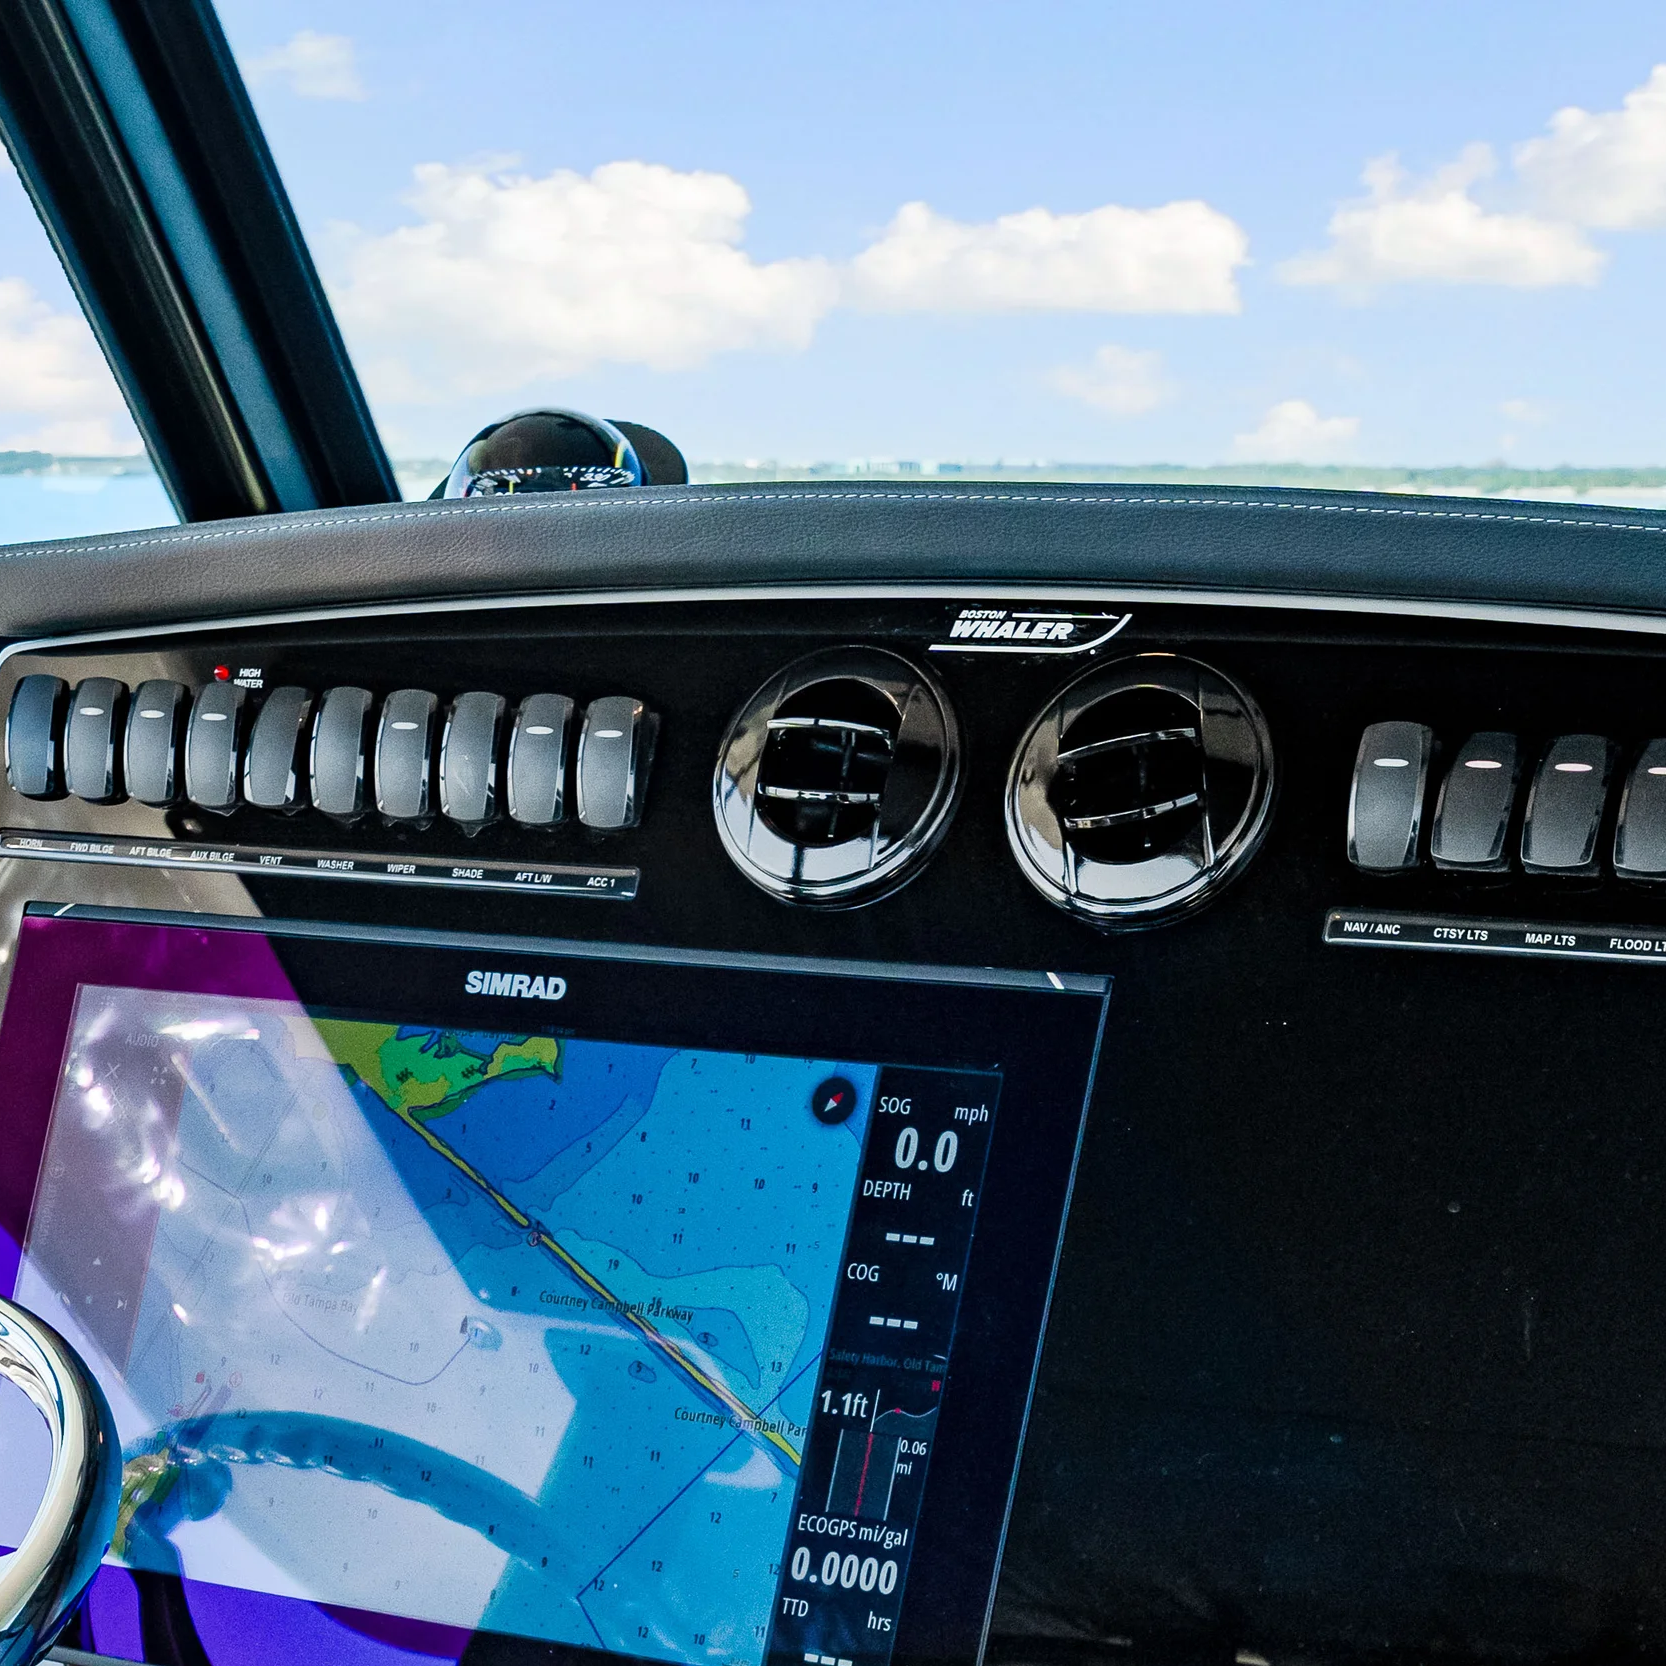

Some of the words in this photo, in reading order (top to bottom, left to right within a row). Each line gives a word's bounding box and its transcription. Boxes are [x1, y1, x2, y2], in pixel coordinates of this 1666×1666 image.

[959, 610, 1007, 619] BOSTON
[950, 621, 1074, 640] WHALER
[239, 669, 261, 677] HIGH
[234, 679, 263, 688] WATER
[20, 839, 42, 847] HORN
[71, 843, 88, 852] FWD
[89, 844, 114, 854] BILGE
[129, 847, 146, 856] AFT
[147, 848, 172, 857] BILGE
[190, 851, 209, 860] AUX
[210, 851, 234, 862] BILGE
[260, 856, 282, 865] VENT
[317, 859, 354, 870] WASHER
[387, 863, 415, 874] WIPER
[452, 868, 483, 879] SHADE
[515, 872, 533, 882] AFT
[534, 873, 552, 883] L/W
[587, 877, 608, 887] ACC
[610, 878, 615, 888] 1
[1344, 922, 1367, 933] NAV
[1375, 924, 1401, 935] ANC
[1433, 928, 1465, 940] CTSY
[1466, 929, 1488, 940] LTS
[1525, 933, 1551, 944] MAP
[1554, 935, 1576, 946] LTS
[1610, 939, 1651, 951] FLOOD
[465, 971, 566, 1000] SIMRAD
[879, 1097, 911, 1115] SOG
[954, 1105, 988, 1125] mph
[895, 1127, 958, 1172] 0.0
[863, 1180, 911, 1200] DEPTH
[962, 1190, 974, 1207] ft
[847, 1264, 879, 1282] COG
[539, 1290, 588, 1309] Courtney
[590, 1296, 644, 1315] Campbell
[647, 1302, 693, 1324] Parkway
[580, 1345, 591, 1355] 12
[771, 1362, 782, 1372] 13
[675, 1407, 726, 1429] Courtney
[729, 1415, 784, 1434] Campbell
[900, 1439, 927, 1455] 0.06
[897, 1462, 912, 1475] mi
[710, 1512, 721, 1524] 12
[798, 1514, 856, 1538] ECOGPS
[859, 1527, 908, 1549] mi/gal
[791, 1547, 898, 1595] 0.0000
[783, 1598, 808, 1617] TTD
[868, 1612, 892, 1631] hrs
